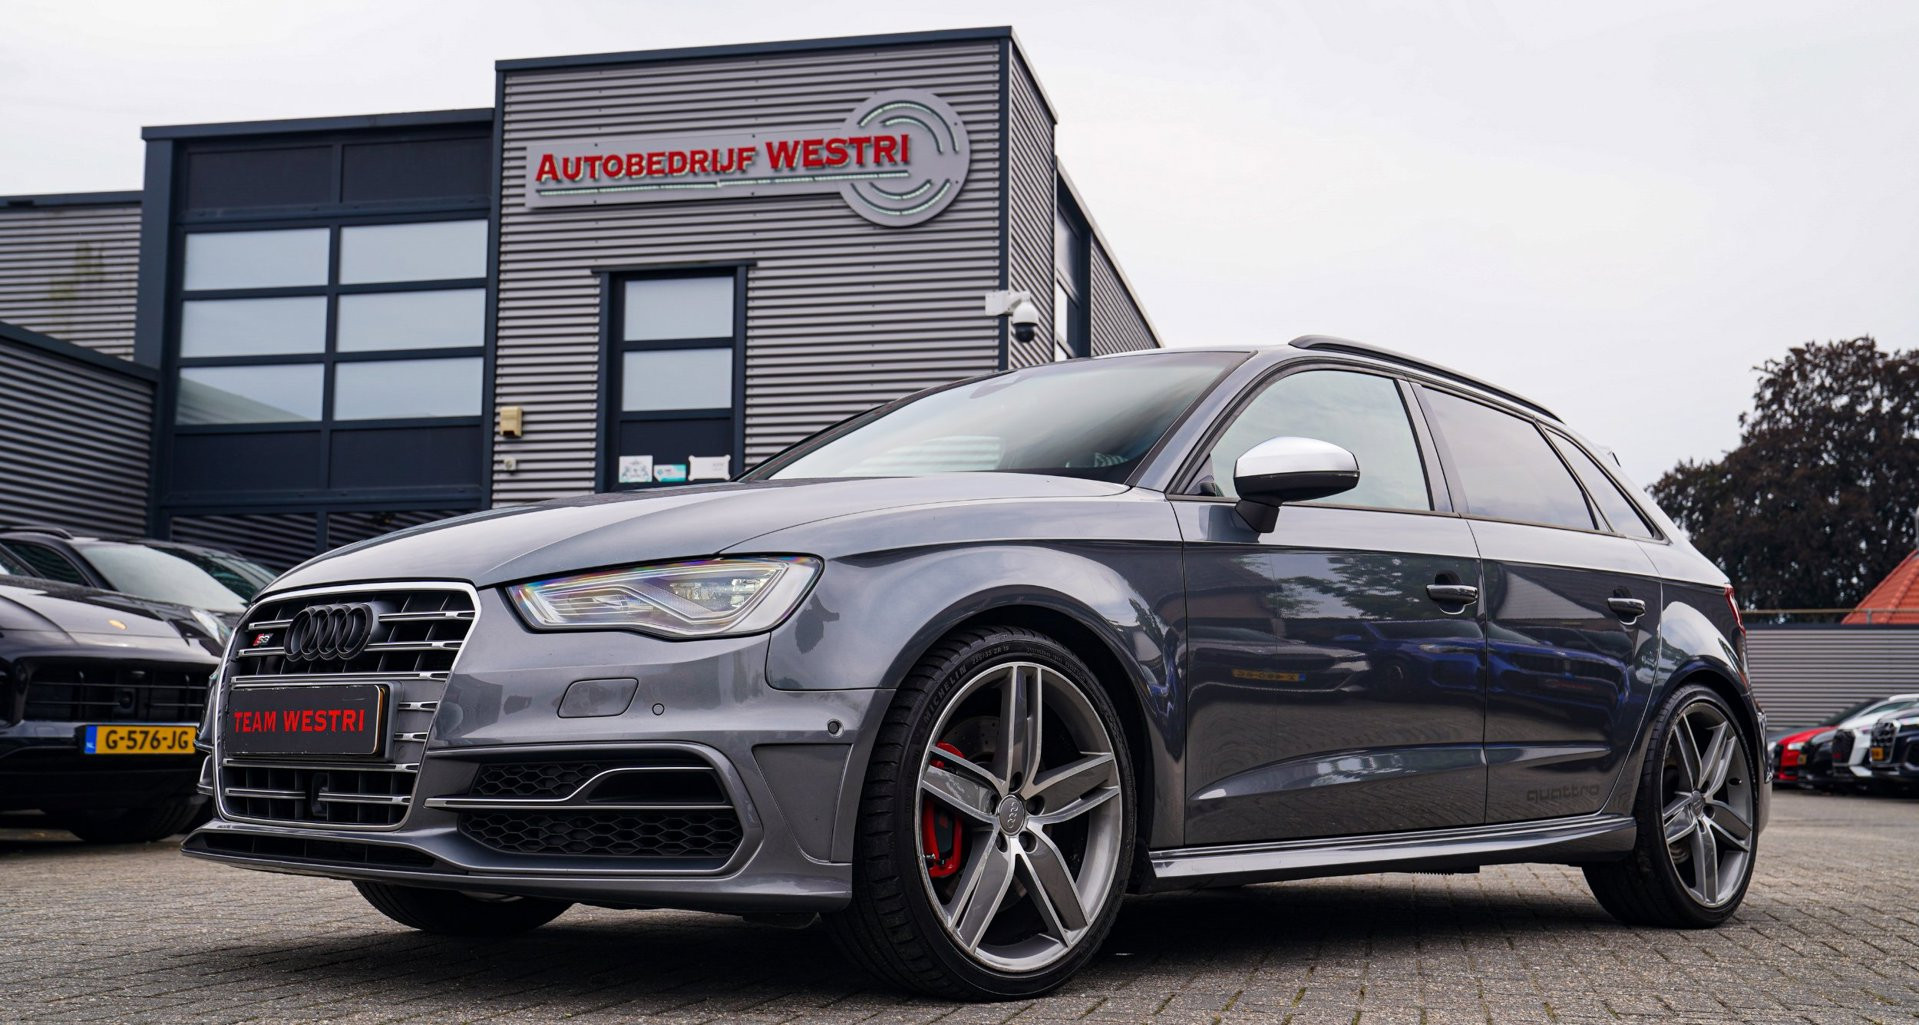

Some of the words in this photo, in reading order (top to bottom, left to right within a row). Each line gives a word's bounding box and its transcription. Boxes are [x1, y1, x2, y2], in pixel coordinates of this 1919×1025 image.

[535, 146, 757, 182] AUTOBEDRIJF
[765, 134, 910, 170] WESTRI
[255, 634, 271, 645] S3
[923, 664, 968, 723] MICHELIN
[234, 711, 277, 733] TEAM
[283, 709, 365, 732] WESTRI
[105, 729, 189, 750] G-576-JG
[1526, 784, 1600, 802] quattro
